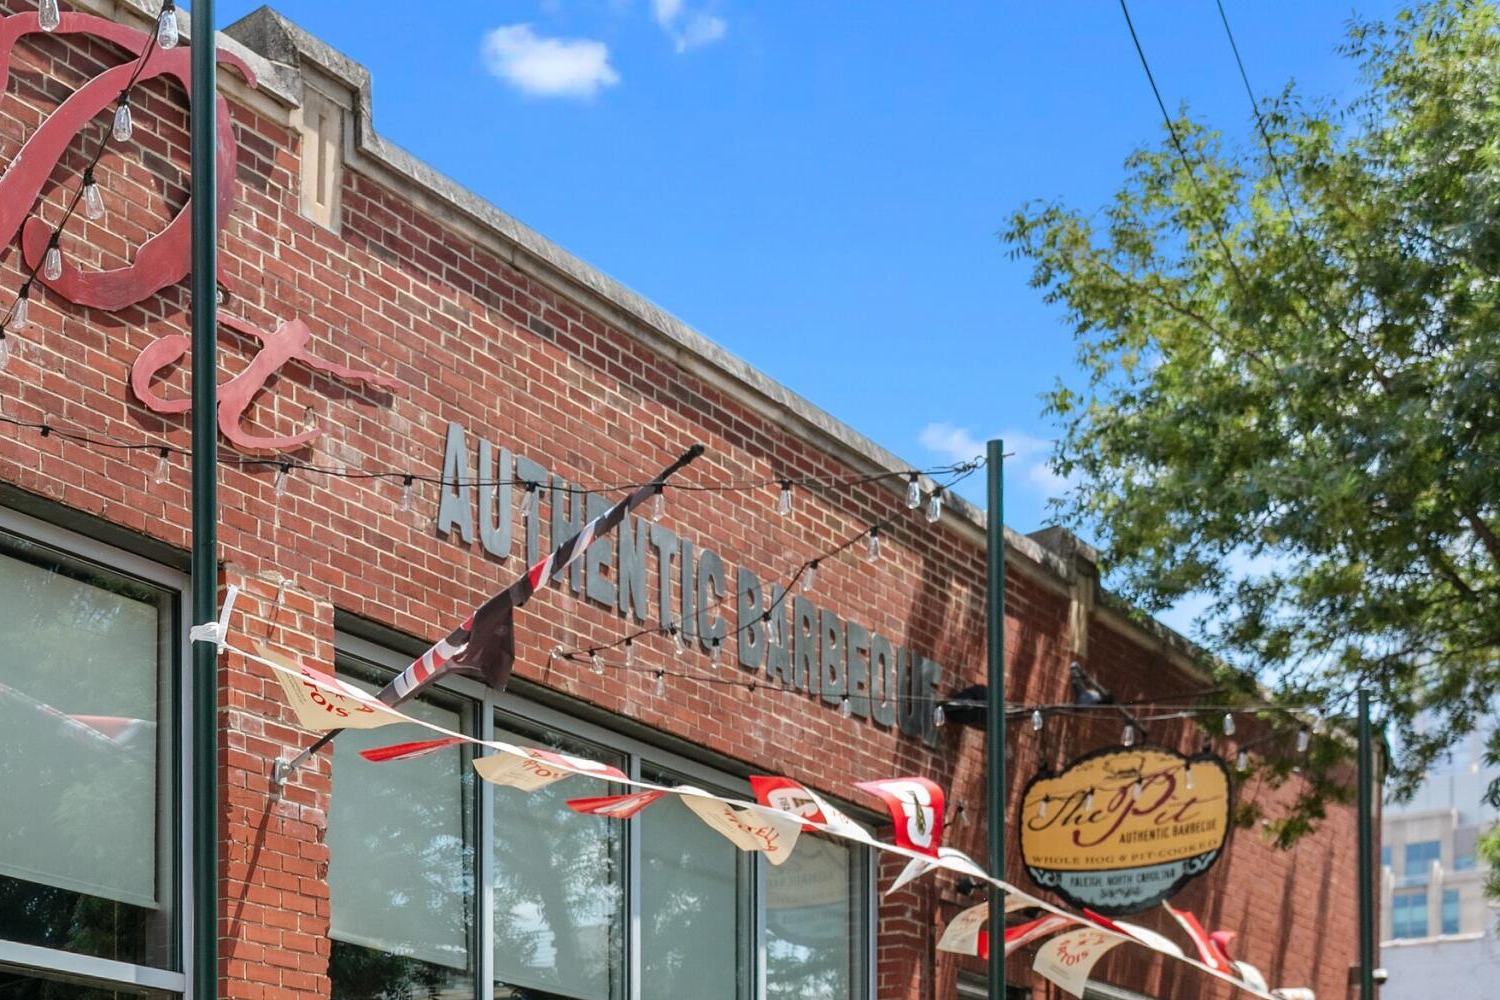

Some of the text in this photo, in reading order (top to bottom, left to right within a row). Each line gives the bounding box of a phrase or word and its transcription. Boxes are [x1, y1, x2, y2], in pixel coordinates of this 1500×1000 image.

[438, 422, 726, 649] AUTHENTIC
[1028, 771, 1222, 848] The Pit
[1119, 819, 1217, 844] AUTHENTIC BARBECUE
[1032, 855, 1080, 865] WHOLE
[1085, 856, 1115, 865] HOG
[1107, 874, 1132, 886] NORTH
